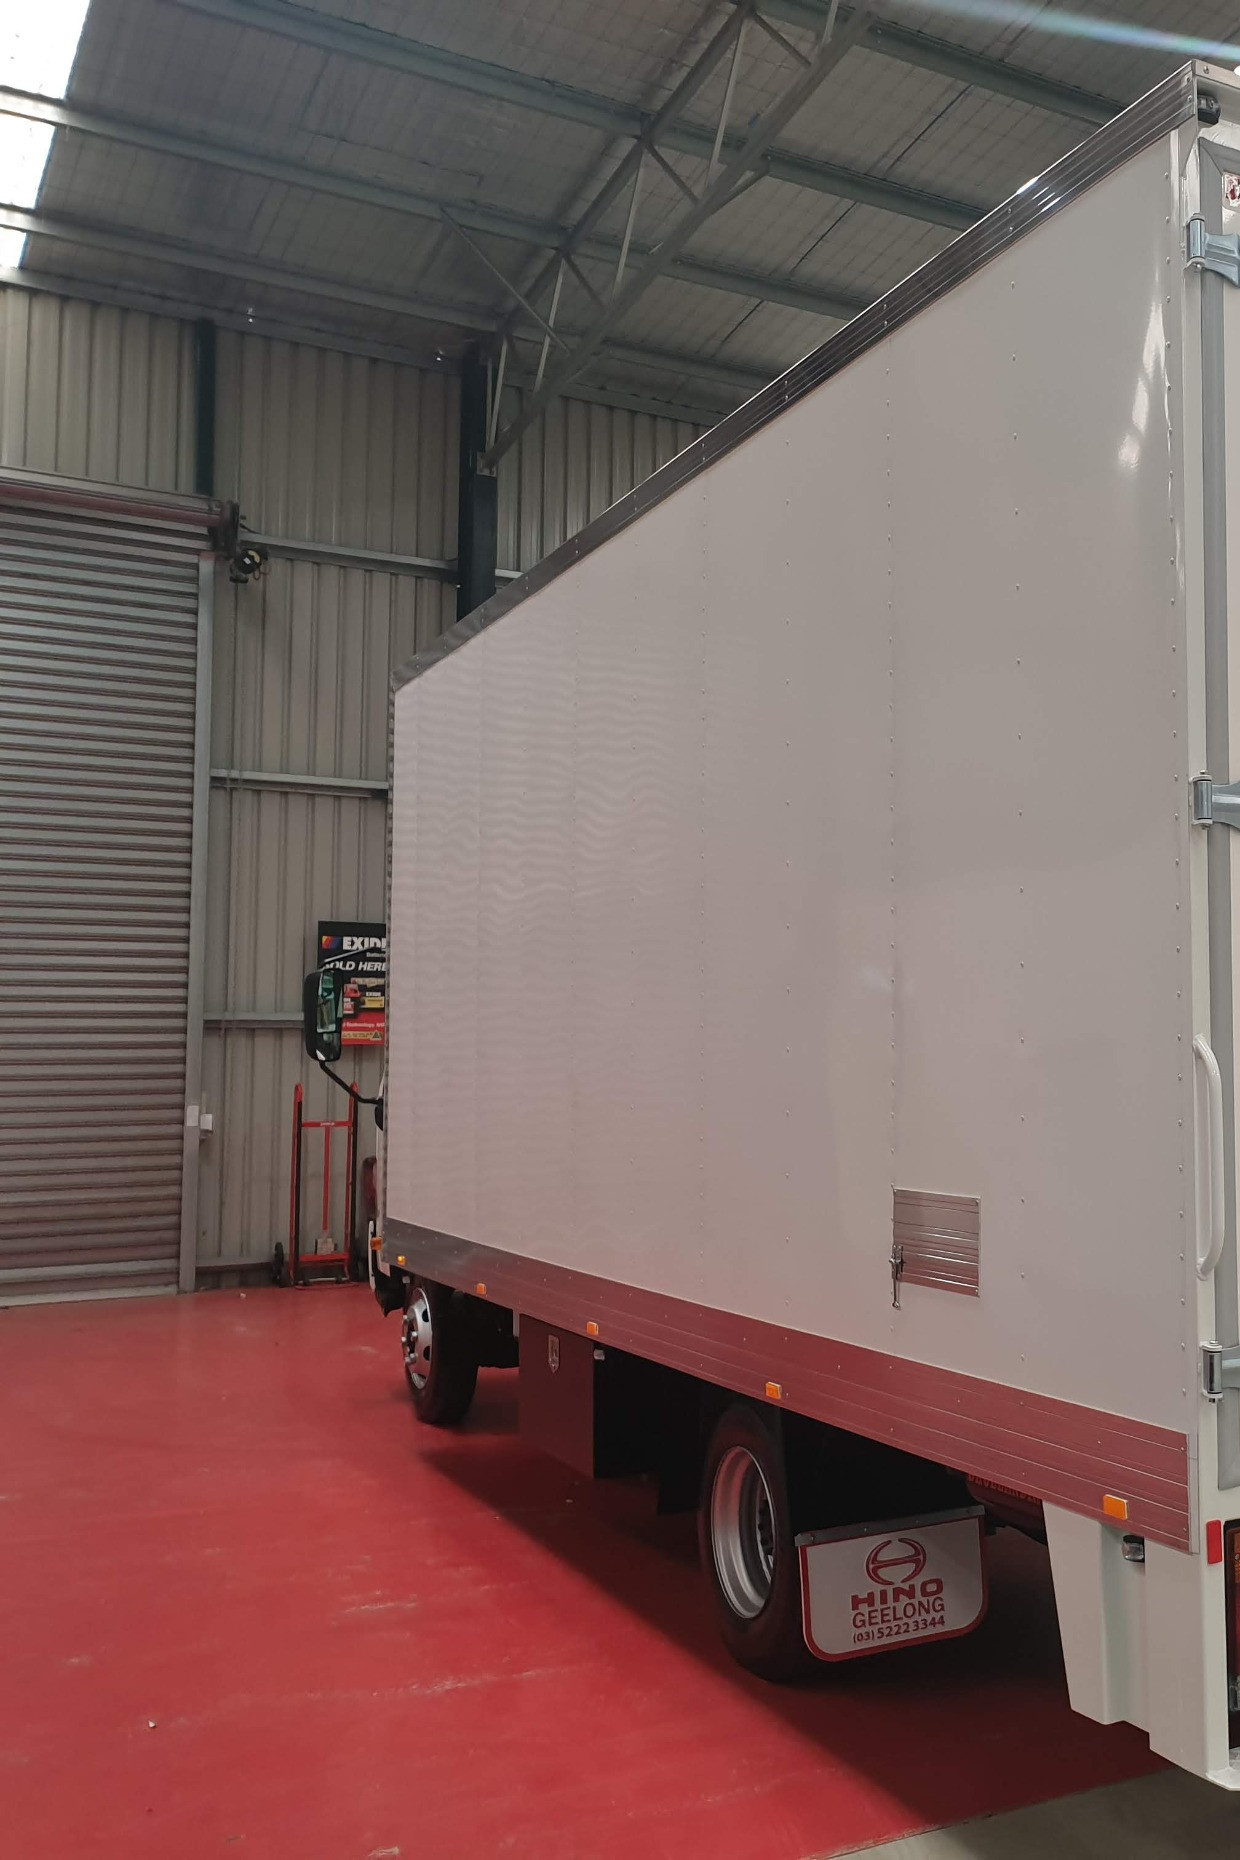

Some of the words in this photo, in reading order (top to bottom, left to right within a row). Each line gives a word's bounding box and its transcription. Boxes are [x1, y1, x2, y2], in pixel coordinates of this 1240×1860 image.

[851, 1578, 944, 1611] HINO
[852, 1596, 945, 1629] GEELONG
[853, 1630, 875, 1643] (03)
